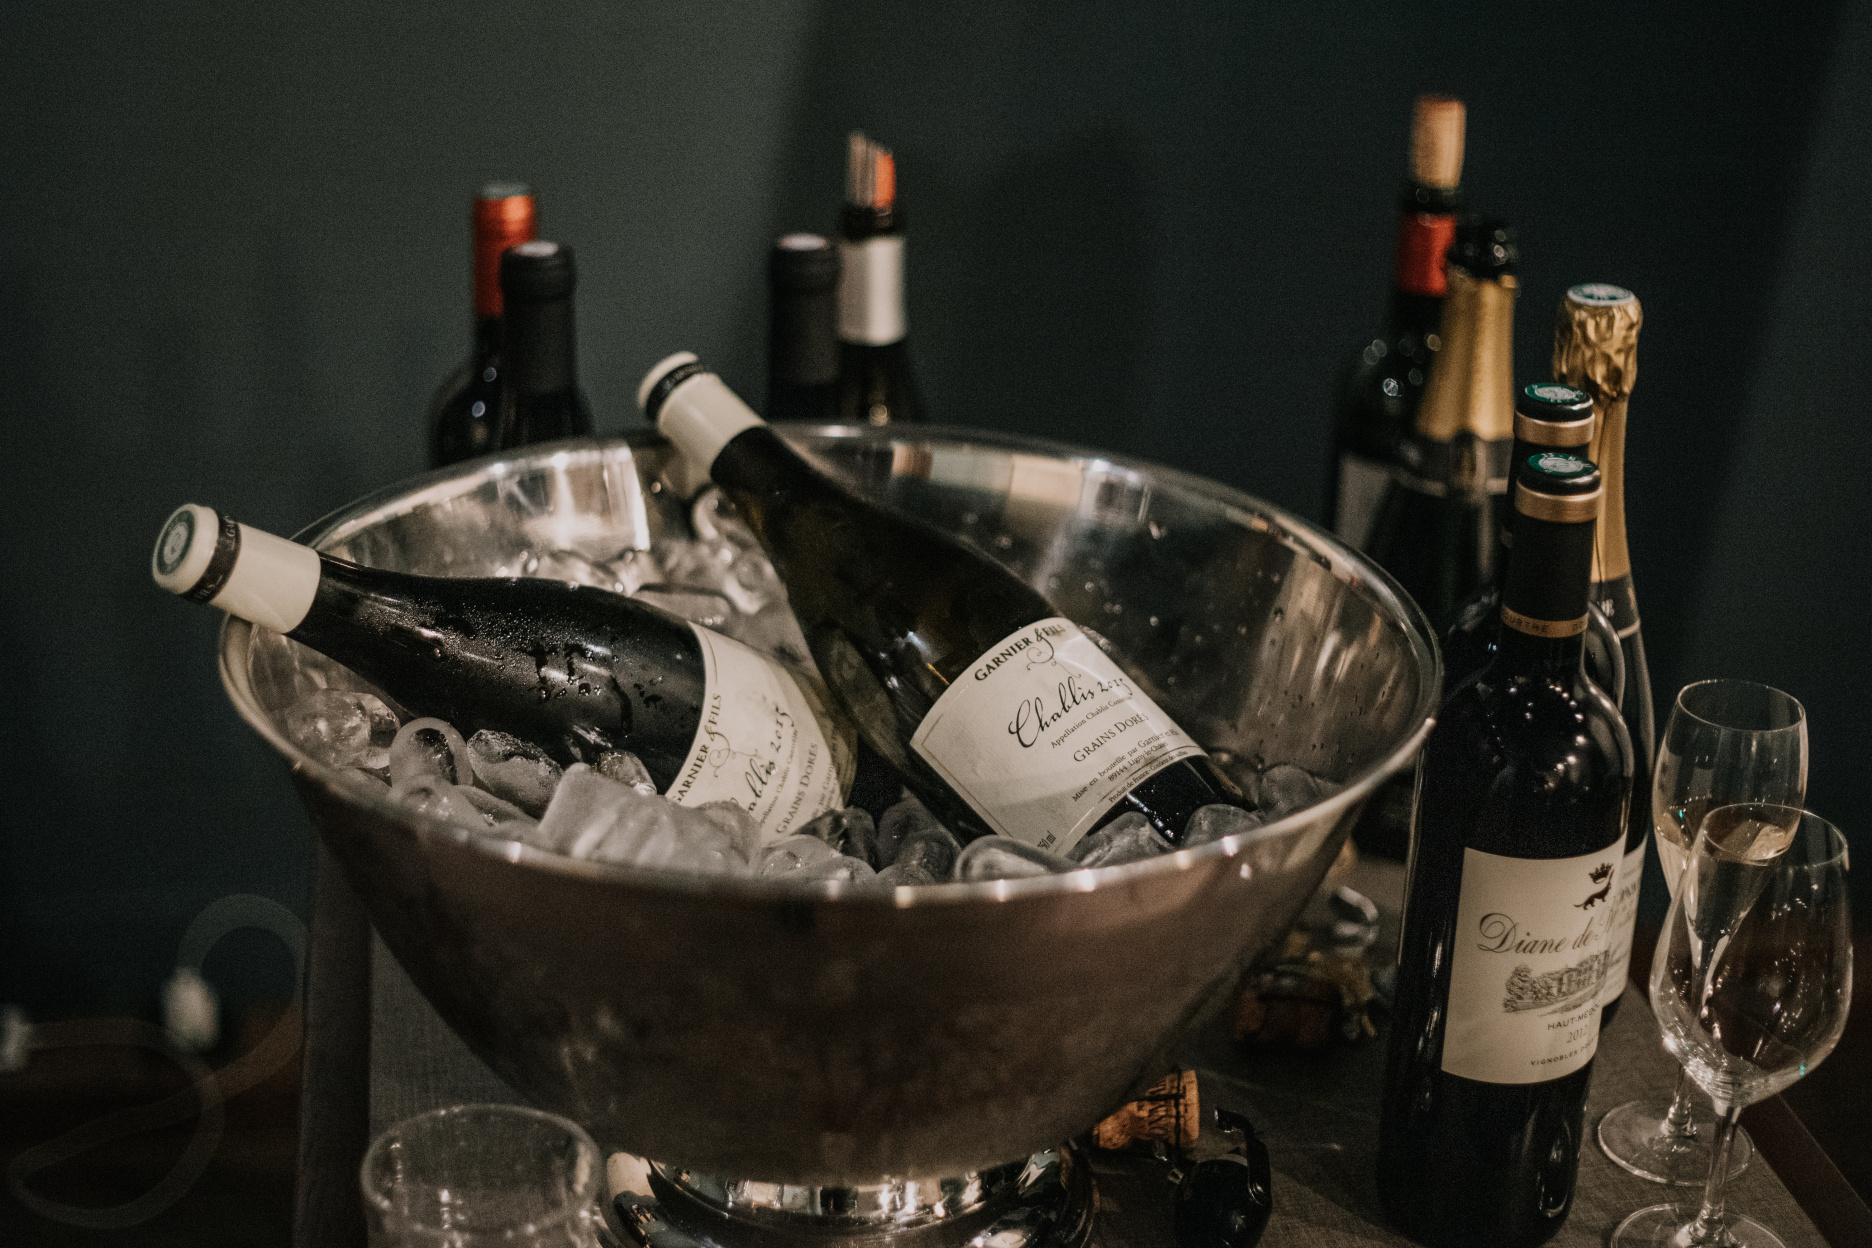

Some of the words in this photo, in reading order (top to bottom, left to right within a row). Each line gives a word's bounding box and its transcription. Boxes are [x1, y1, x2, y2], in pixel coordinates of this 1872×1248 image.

[974, 637, 1033, 681] GARNIER
[769, 704, 795, 754] 2015
[1007, 676, 1095, 749] Chablis
[1050, 717, 1088, 750] Appellation
[1085, 700, 1110, 721] Chablis
[672, 743, 710, 804] GARNIER
[708, 692, 723, 727] FILS
[1072, 728, 1117, 763] GRAINS
[1072, 785, 1089, 802] Mise
[1088, 776, 1099, 787] en
[1098, 754, 1127, 777] bouteille
[1127, 746, 1138, 757] par
[1138, 732, 1165, 749] Garnier
[1108, 784, 1128, 803] Produit
[1126, 778, 1135, 788] de
[1133, 770, 1149, 785] France
[760, 792, 780, 827] ppellation
[775, 785, 805, 835] GRAINS
[1046, 829, 1057, 844] ml
[1477, 911, 1569, 955] Diane
[1571, 923, 1592, 950] de
[1530, 1048, 1579, 1067] VIGNOBLES
